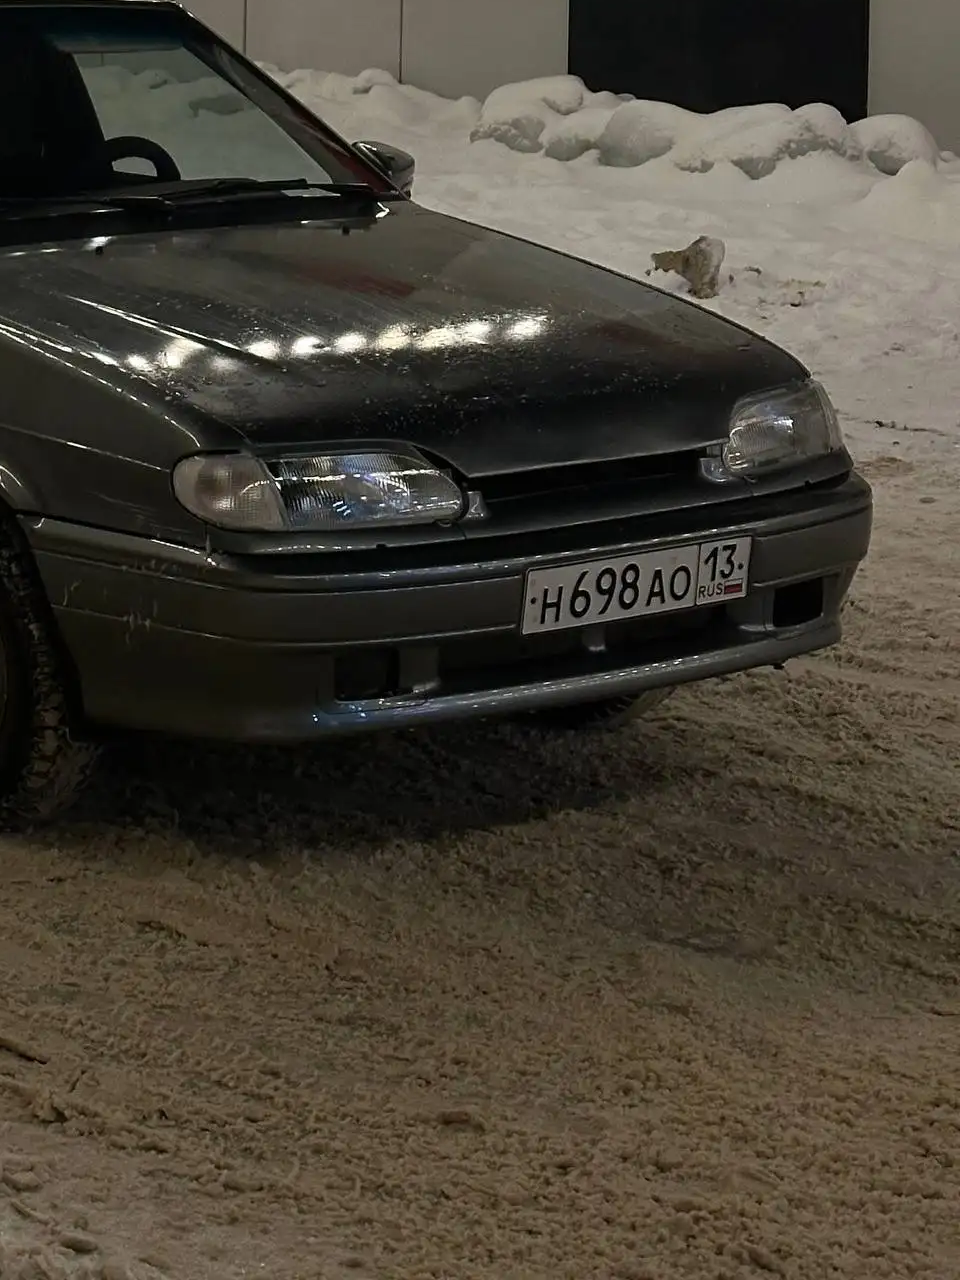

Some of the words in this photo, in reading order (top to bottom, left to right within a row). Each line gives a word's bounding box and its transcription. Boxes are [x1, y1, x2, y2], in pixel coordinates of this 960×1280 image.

[540, 563, 691, 624] Н698АО
[704, 544, 738, 582] 13
[698, 583, 724, 599] RUS
